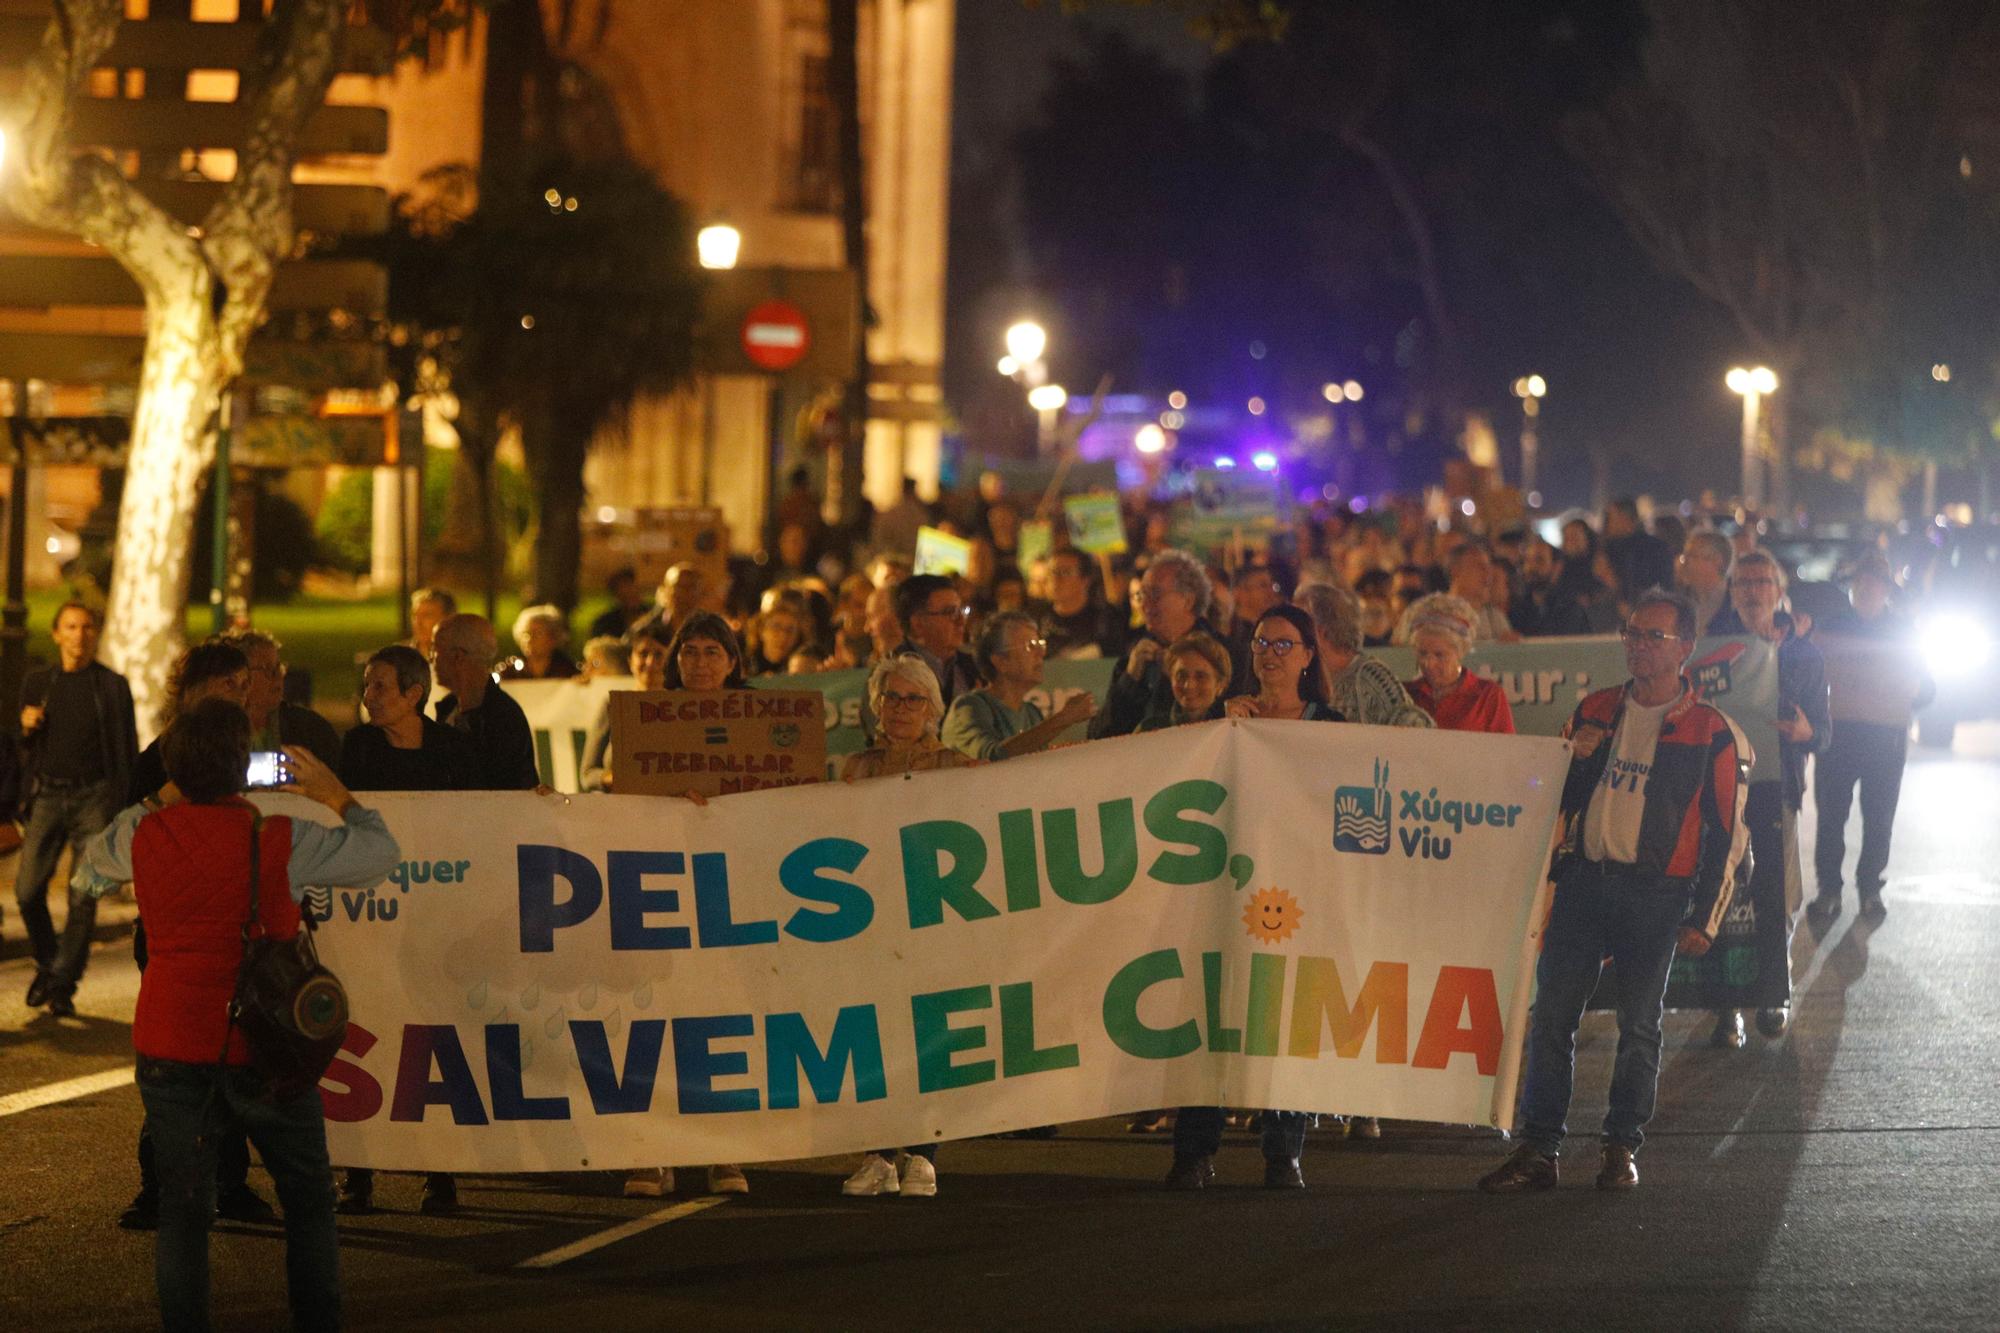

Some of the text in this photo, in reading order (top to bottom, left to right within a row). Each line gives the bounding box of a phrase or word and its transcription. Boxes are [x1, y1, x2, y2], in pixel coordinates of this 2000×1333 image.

[1400, 787, 1522, 834] Xúquer
[517, 779, 1255, 953] PELS RIUS,
[1399, 825, 1452, 860] Viu
[341, 888, 398, 922] Viu
[317, 948, 1504, 1126] SALVEM EL CLIMA
